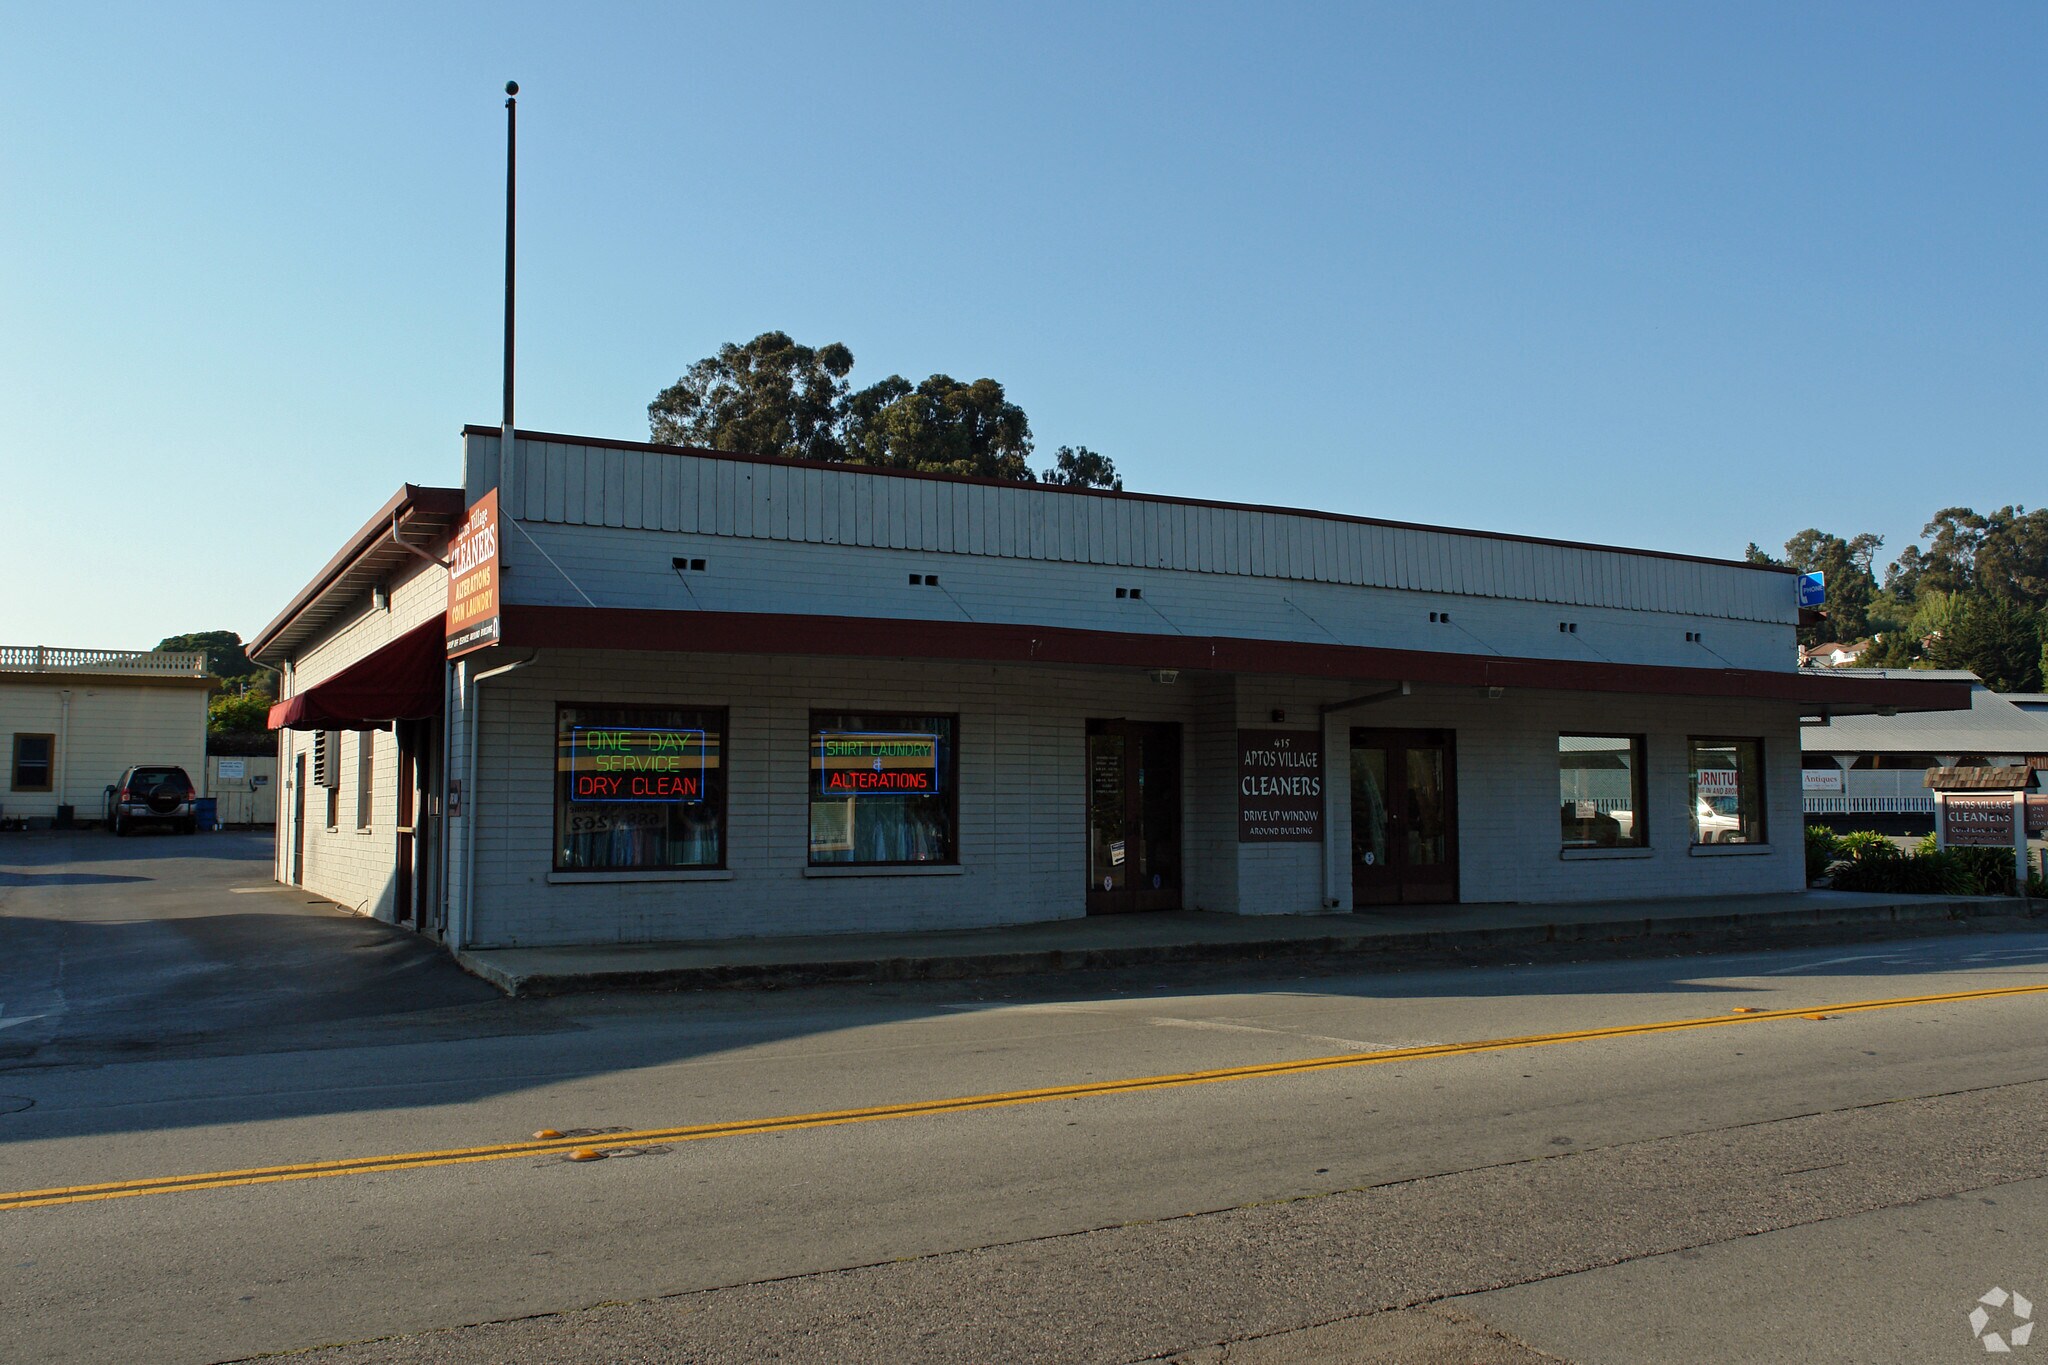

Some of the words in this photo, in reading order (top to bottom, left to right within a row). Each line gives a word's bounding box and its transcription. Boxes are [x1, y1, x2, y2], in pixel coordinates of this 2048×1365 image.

[471, 507, 488, 530] Village
[451, 523, 496, 580] CLEANERS
[455, 566, 491, 602] ALTERATIONS
[1803, 585, 1823, 594] PHONE
[452, 602, 465, 625] COIN
[466, 588, 493, 618] LAUNDRY
[586, 731, 632, 751] ONE
[648, 732, 691, 751] DAY
[826, 741, 865, 756] SHIRT
[870, 742, 932, 757] LAUNDRY
[1273, 738, 1291, 748] 415
[596, 755, 681, 773] SERVICE
[872, 756, 883, 773] &
[1244, 750, 1276, 767] APTOS
[1278, 751, 1318, 768] VILLAGE
[579, 776, 622, 796] DRY
[632, 777, 697, 796] CLEAN
[829, 772, 928, 789] ALTERATIONS
[1241, 775, 1321, 797] CLEANERS
[1804, 774, 1837, 784] Antiques
[1713, 787, 1724, 795] AND
[1949, 800, 1975, 809] APTOS
[1976, 801, 2012, 810] VILLAGE
[1244, 810, 1267, 821] DRIVE
[1268, 810, 1280, 821] UP
[1281, 810, 1319, 822] WINDOW
[1948, 812, 2012, 822] CLEANERS
[1249, 827, 1279, 835] AROUND
[1280, 827, 1313, 835] BUILDING
